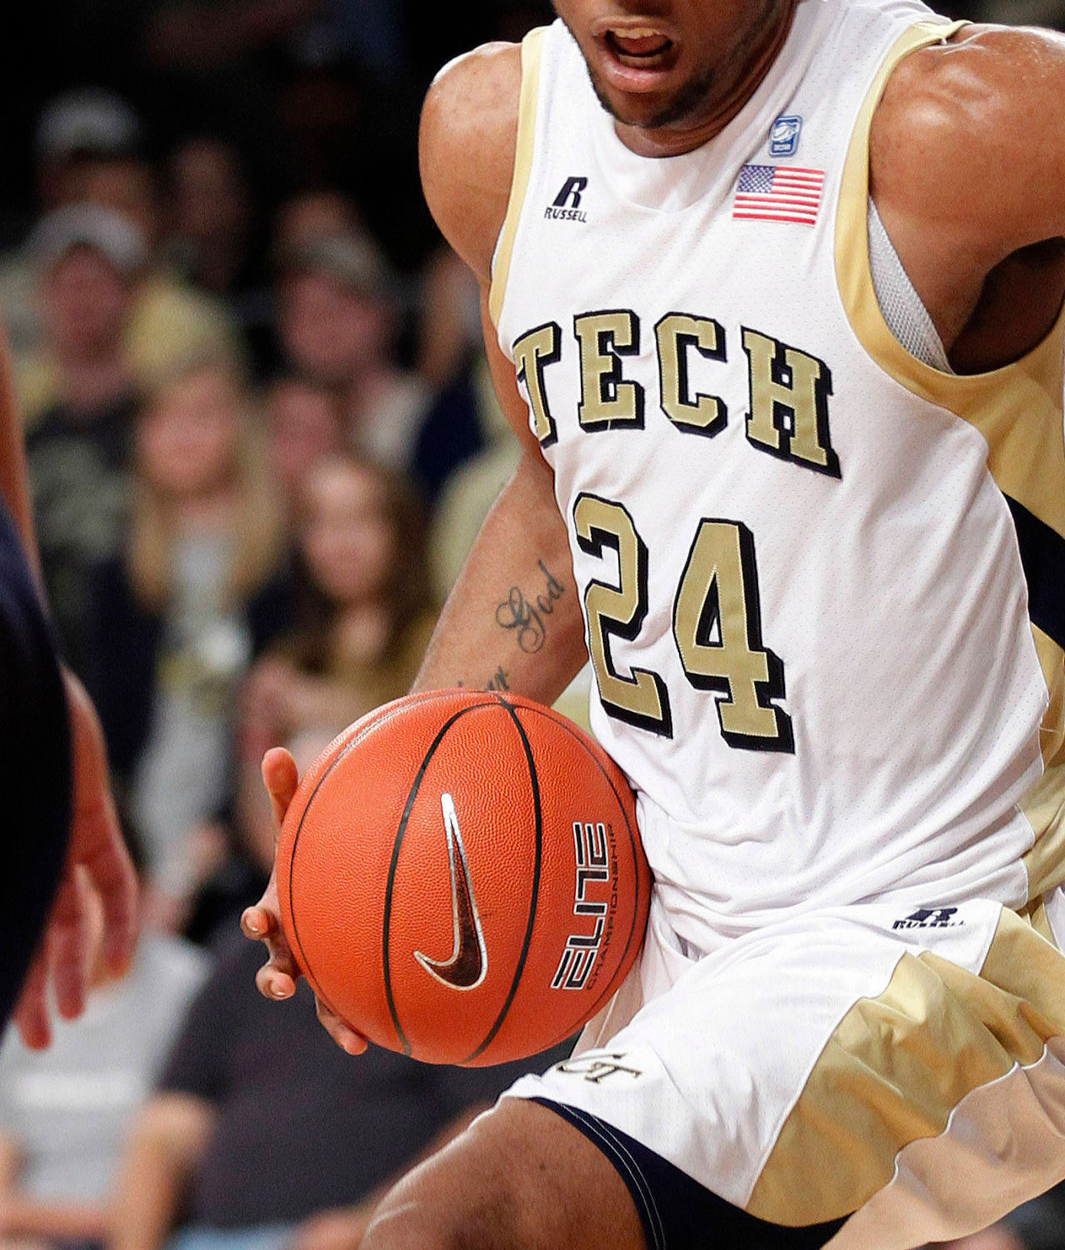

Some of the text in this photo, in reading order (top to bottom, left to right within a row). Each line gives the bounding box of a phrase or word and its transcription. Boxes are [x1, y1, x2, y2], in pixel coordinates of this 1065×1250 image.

[544, 207, 588, 223] RUSSELL
[512, 309, 842, 479] TECH
[496, 558, 565, 654] God
[573, 492, 796, 754] 24
[550, 821, 610, 990] ELITE
[586, 823, 619, 990] CHAMPIONSHIP
